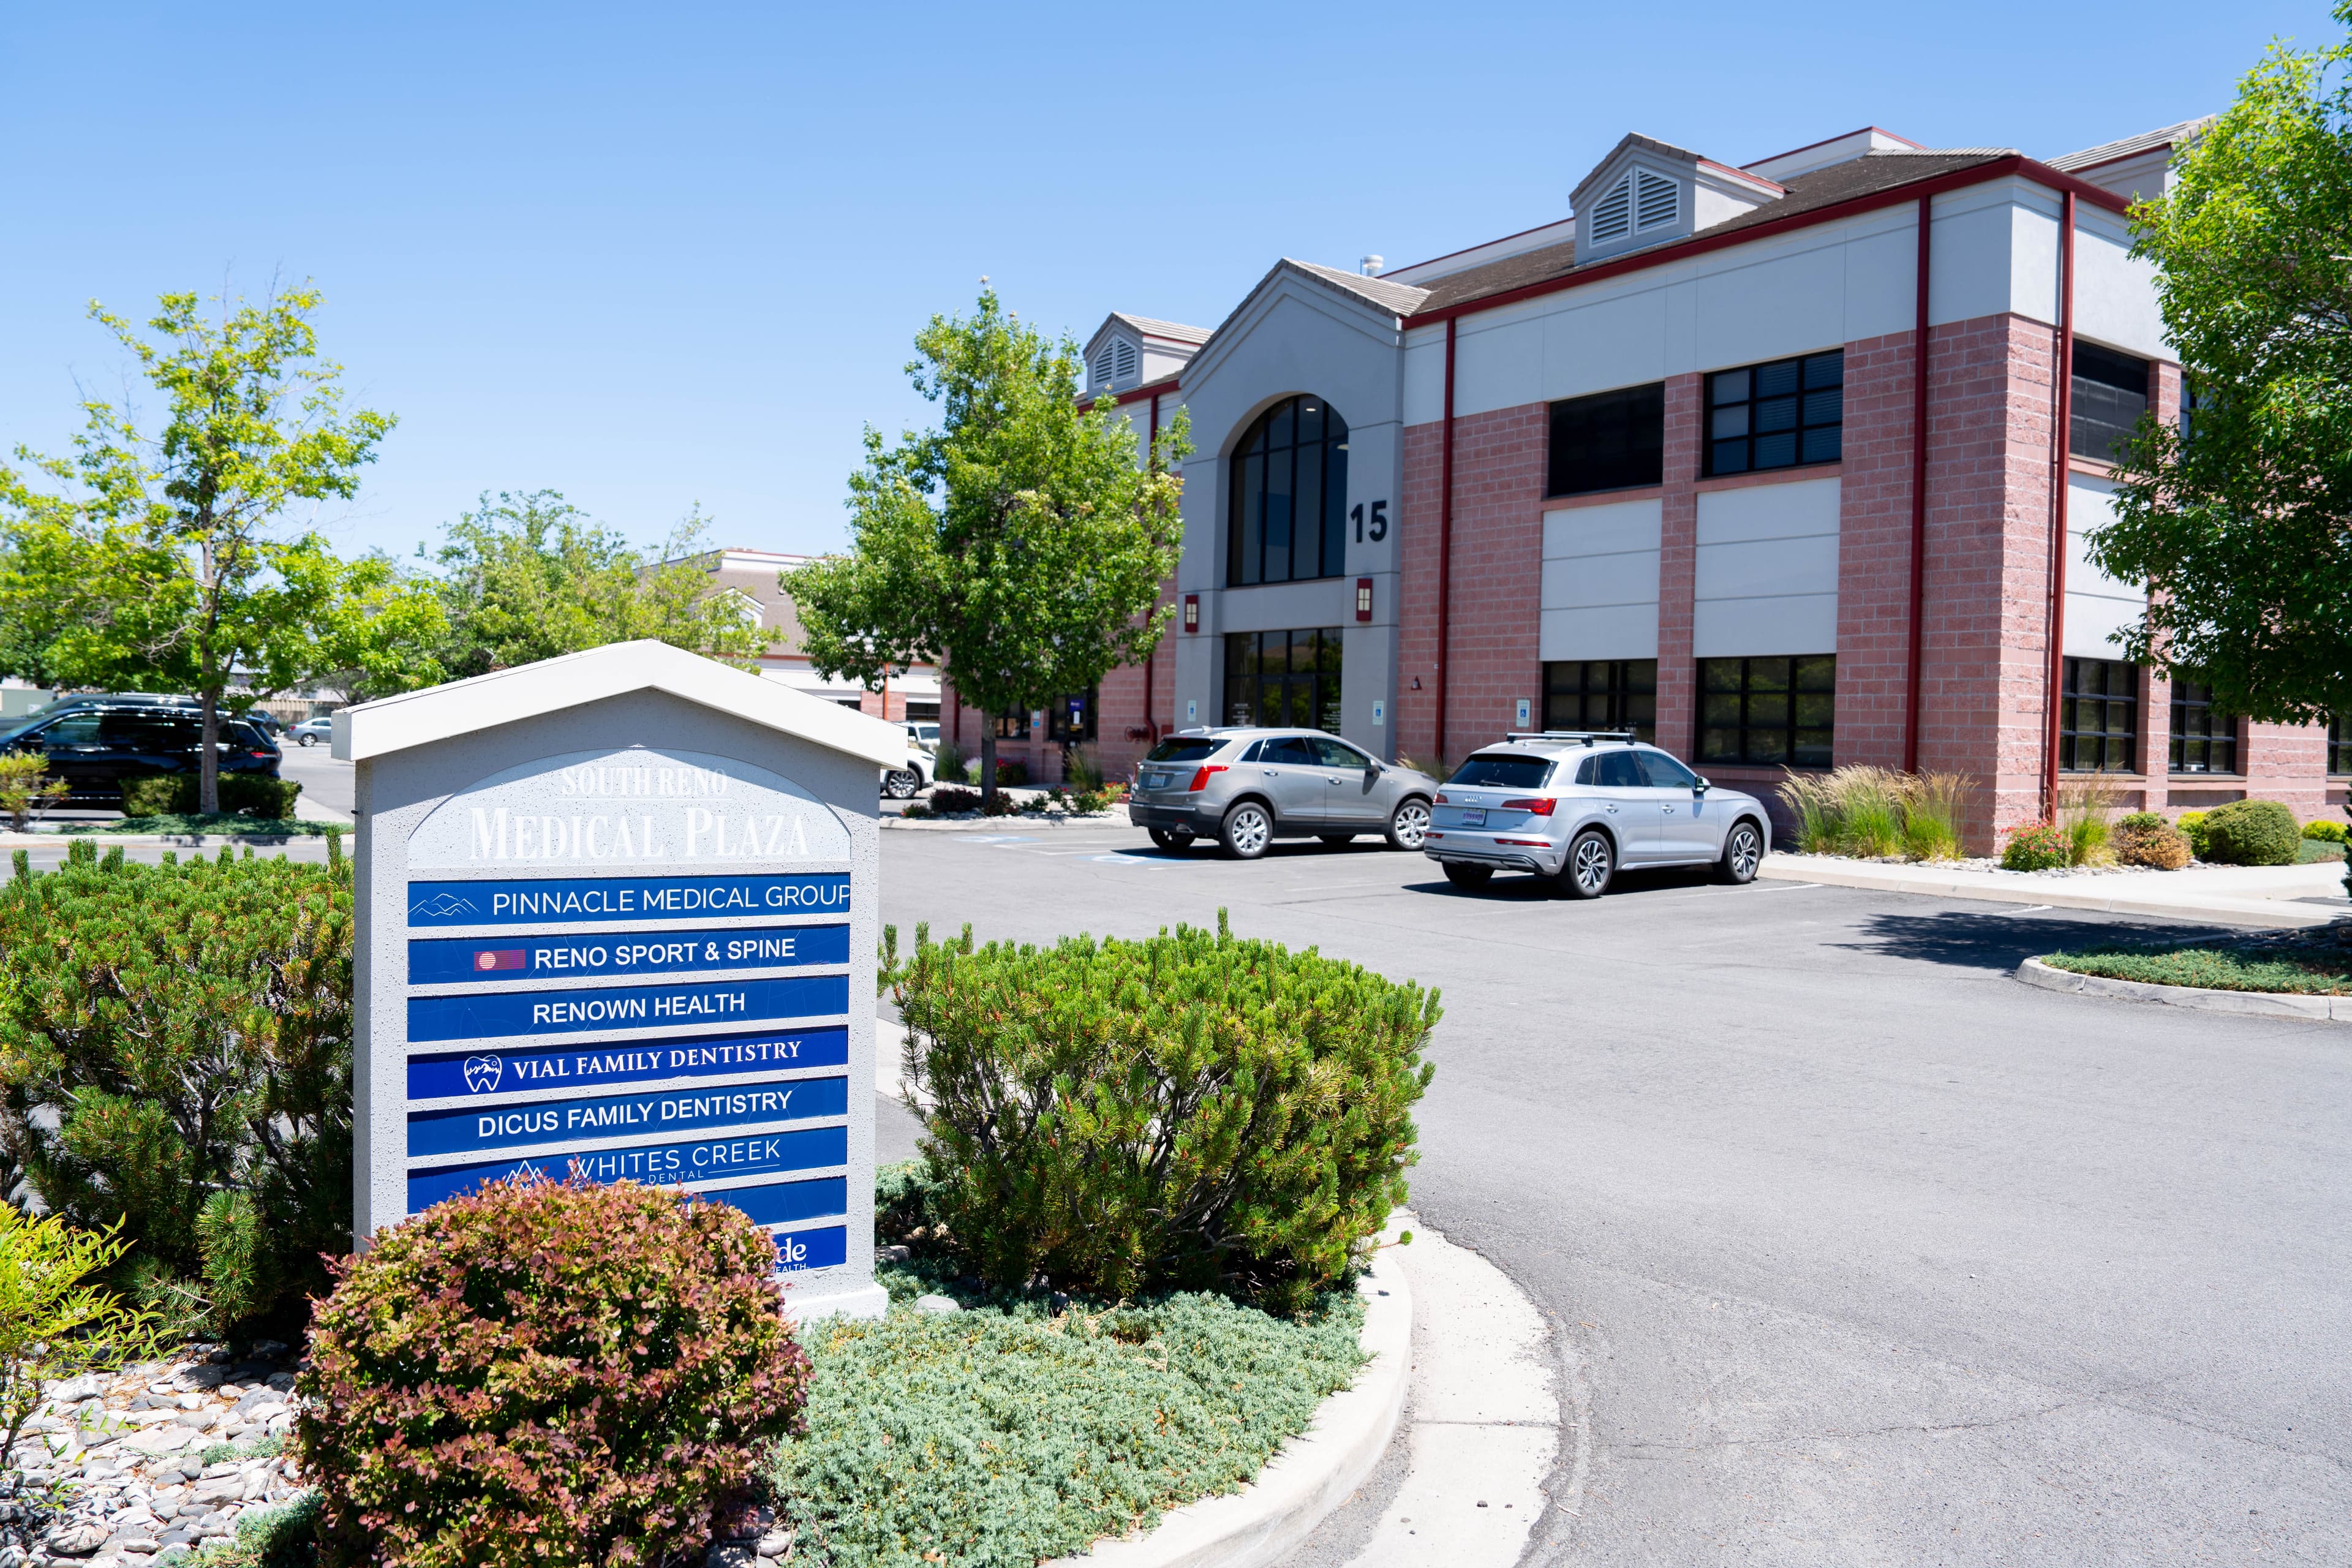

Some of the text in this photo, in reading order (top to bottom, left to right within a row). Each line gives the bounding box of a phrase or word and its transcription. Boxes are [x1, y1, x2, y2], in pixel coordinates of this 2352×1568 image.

[1350, 499, 1388, 544] 15
[561, 767, 728, 796] SOUTH RENO
[469, 805, 810, 860] MEDICAL PLAZA
[493, 884, 850, 916] PINNACLE MEDICAL GROUP
[535, 938, 795, 969] RENO SPORT & SPINE
[533, 993, 745, 1024] RENOWN HEALTH
[513, 1041, 802, 1080] VIAL FAMILY DENTISTRY
[478, 1090, 793, 1137] DICUS FAMILY DENTISTRY
[567, 1139, 781, 1179] WHITES CREEK
[648, 1169, 704, 1185] DENTAL
